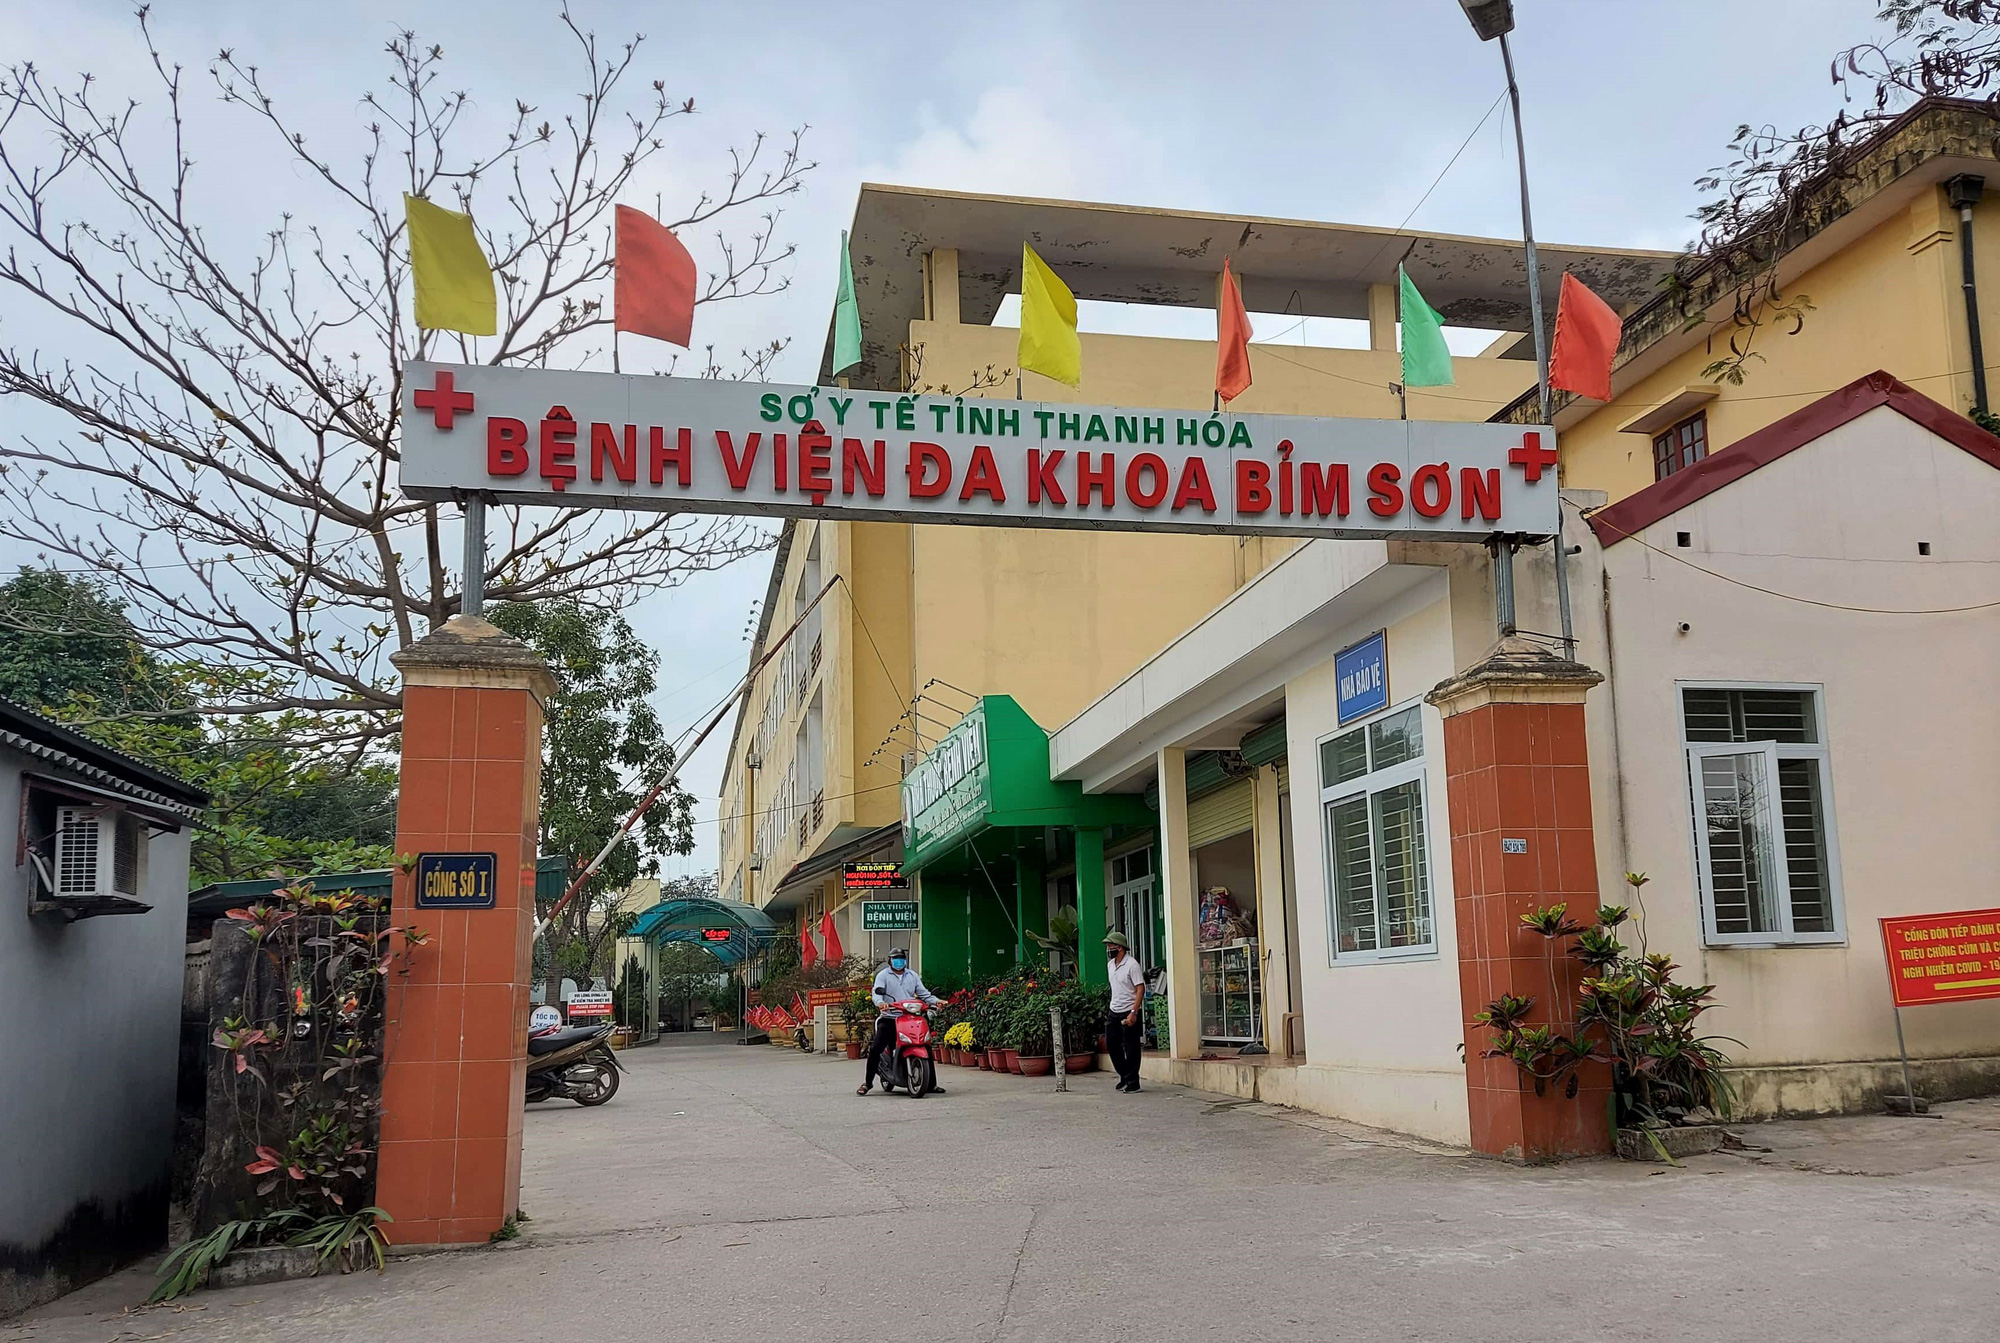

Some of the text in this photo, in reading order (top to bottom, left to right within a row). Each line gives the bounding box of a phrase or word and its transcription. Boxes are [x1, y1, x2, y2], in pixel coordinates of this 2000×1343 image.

[761, 385, 1254, 449] SỞ Y TẾ TỈNH THANH HÓA
[486, 404, 1502, 521] BỆNH VIỆN ĐA KHOA BỈM SƠN
[1340, 656, 1381, 703] NHÀ BẢO VỆ
[425, 860, 457, 898] CỔNG
[459, 861, 476, 898] SỐ
[866, 910, 917, 923] BỆNH VIỆN
[1904, 926, 1930, 942] CỔNG
[1930, 926, 1949, 940] ĐÓN
[1950, 923, 1969, 938] TIẾP
[1971, 922, 1996, 936] DÀNH
[1899, 946, 1925, 962] TRIỆU
[1927, 944, 1957, 959] CHỨNG
[1958, 941, 1978, 956] CÚM
[1980, 940, 1992, 954] VÀ
[1902, 966, 1925, 979] NGHI
[1926, 960, 1955, 977] NHIỄM
[1956, 961, 1982, 974] COVID
